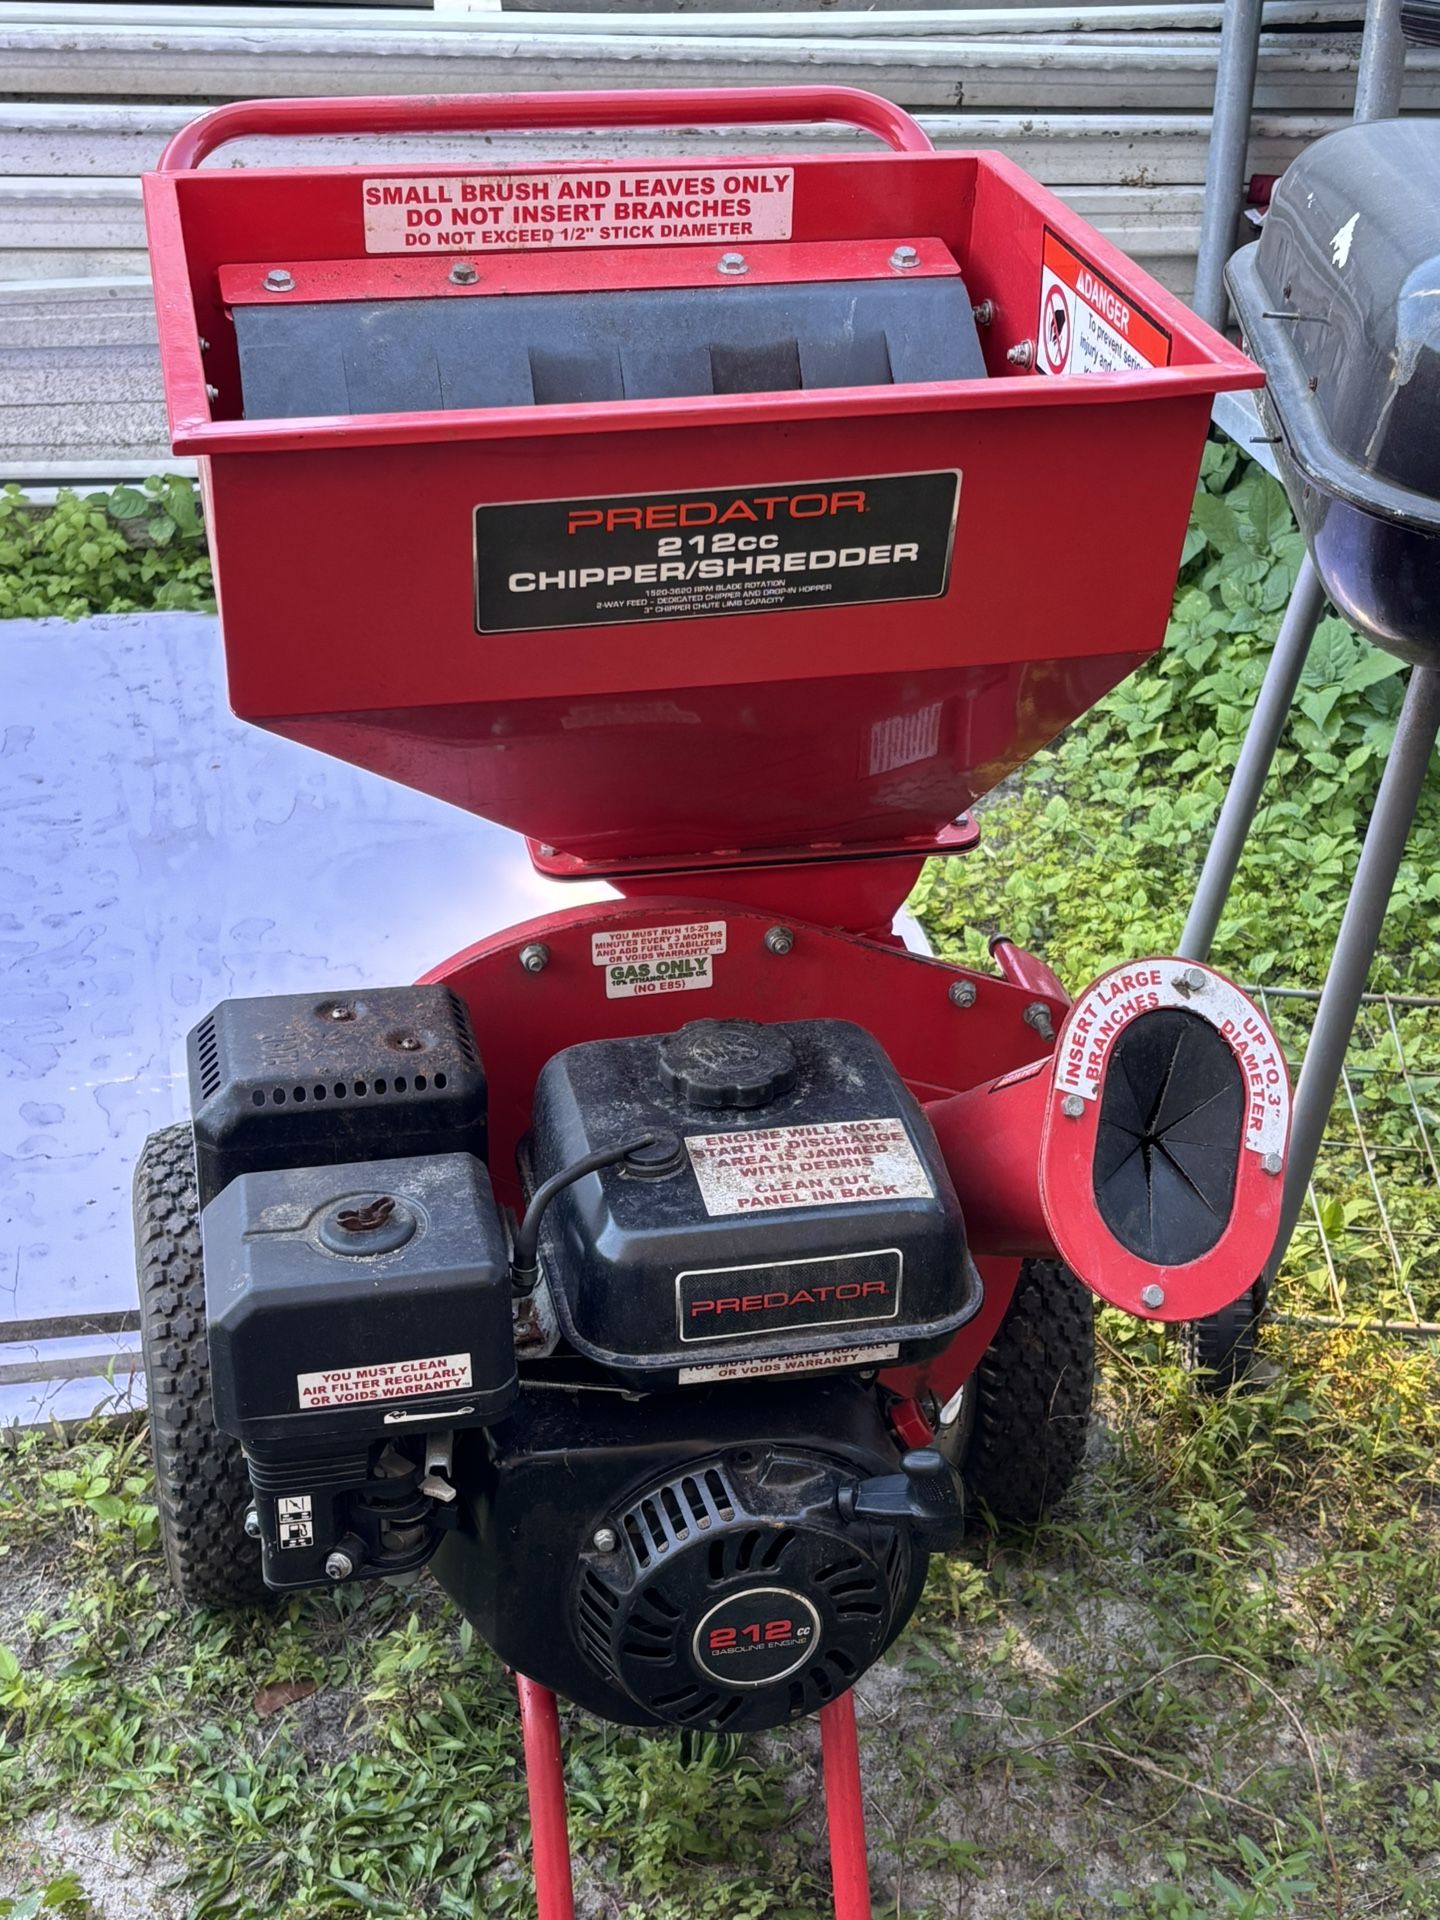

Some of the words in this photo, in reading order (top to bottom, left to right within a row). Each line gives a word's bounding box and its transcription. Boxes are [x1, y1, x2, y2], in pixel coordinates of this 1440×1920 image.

[366, 185, 453, 205] SMALL
[461, 182, 549, 203] BRUSH
[557, 180, 611, 201] AND
[619, 177, 715, 198] LEAVES
[723, 174, 790, 194] ONLY
[406, 208, 442, 227] DO
[452, 206, 504, 226] NOT
[513, 203, 606, 224] INSERT
[614, 198, 752, 221] BRANCHES
[405, 232, 431, 247] DO
[437, 230, 476, 245] NOT
[482, 228, 554, 244] EXCEED
[560, 226, 594, 241] 1/2"
[600, 225, 654, 239] STICK
[660, 222, 753, 238] DIAMETER
[1084, 274, 1130, 335] DANGER
[1080, 331, 1098, 365] injury
[1088, 312, 1096, 333] To
[1097, 326, 1122, 359] prevent
[567, 490, 867, 535] PREDATOR
[657, 532, 779, 558] 212cc
[508, 542, 920, 594] CHIPPER/SHREDDER
[596, 600, 625, 609] 2-WAY
[626, 598, 647, 607] FEED
[657, 595, 703, 605] DEDICATED
[705, 591, 741, 601] CHIPPER
[743, 589, 761, 598] AND
[763, 585, 797, 596] DROP-IN
[798, 583, 832, 593] HOPPER
[694, 584, 713, 593] RPM
[715, 582, 742, 592] BLADE
[744, 579, 786, 590] ROTATION
[655, 603, 691, 613] CHIPPER
[692, 601, 720, 610] CHUTE
[744, 596, 785, 606] CAPACITY
[595, 940, 638, 950] MINUTES
[641, 936, 672, 945] EVERY
[683, 931, 723, 940] MONTHS
[609, 932, 629, 941] YOU
[632, 930, 659, 939] MUST
[661, 928, 681, 936] RUN
[684, 924, 709, 933] 15-20
[596, 949, 616, 957] AND
[619, 947, 638, 955] ADD
[641, 944, 665, 953] FUEL
[668, 939, 722, 950] STABILIZER
[608, 955, 622, 963] OR
[625, 952, 654, 961] VOIDS
[656, 947, 710, 958] WARRANTY
[610, 963, 650, 980] GAS
[656, 957, 708, 974] ONLY
[634, 983, 655, 995] (NO
[660, 979, 686, 991] E85)
[1064, 1002, 1098, 1087] INSERT
[1097, 970, 1163, 1005] LARGE
[1085, 991, 1160, 1082] BRANCHES
[1242, 1016, 1267, 1048] UP
[1262, 1052, 1280, 1086] TO
[1221, 1018, 1265, 1132] DIAMETER
[691, 1144, 757, 1159] START
[763, 1141, 781, 1152] IF
[786, 1131, 904, 1149] DISCHARGE
[704, 1130, 781, 1146] ENGINE
[786, 1126, 837, 1138] WILL
[841, 1122, 881, 1134] NOT
[717, 1154, 771, 1168] AREA
[777, 1151, 797, 1162] IS
[804, 1144, 889, 1159] JAMMED
[739, 1165, 793, 1178] WITH
[800, 1157, 874, 1173] DEBRIS
[737, 1191, 807, 1209] PANEL
[812, 1190, 834, 1201] IN
[841, 1184, 900, 1199] BACK
[755, 1178, 823, 1194] CLEAN
[829, 1174, 872, 1187] OUT
[690, 1280, 888, 1317] PREDATOR
[322, 1372, 351, 1383] YOU
[356, 1366, 397, 1379] MUST
[401, 1359, 448, 1373] CLEAN
[718, 1369, 737, 1377] OR
[741, 1363, 781, 1374] VOIDS
[785, 1354, 859, 1370] WARRANTY
[302, 1385, 326, 1396] AIR
[331, 1379, 380, 1393] FILTER
[384, 1366, 468, 1387] REGULARLY
[310, 1396, 331, 1406] OR
[335, 1390, 379, 1404] VOIDS
[382, 1377, 462, 1397] WARRANTY
[709, 1619, 792, 1648] 212
[711, 1642, 765, 1656] GASOLINE
[768, 1637, 807, 1649] ENGINE
